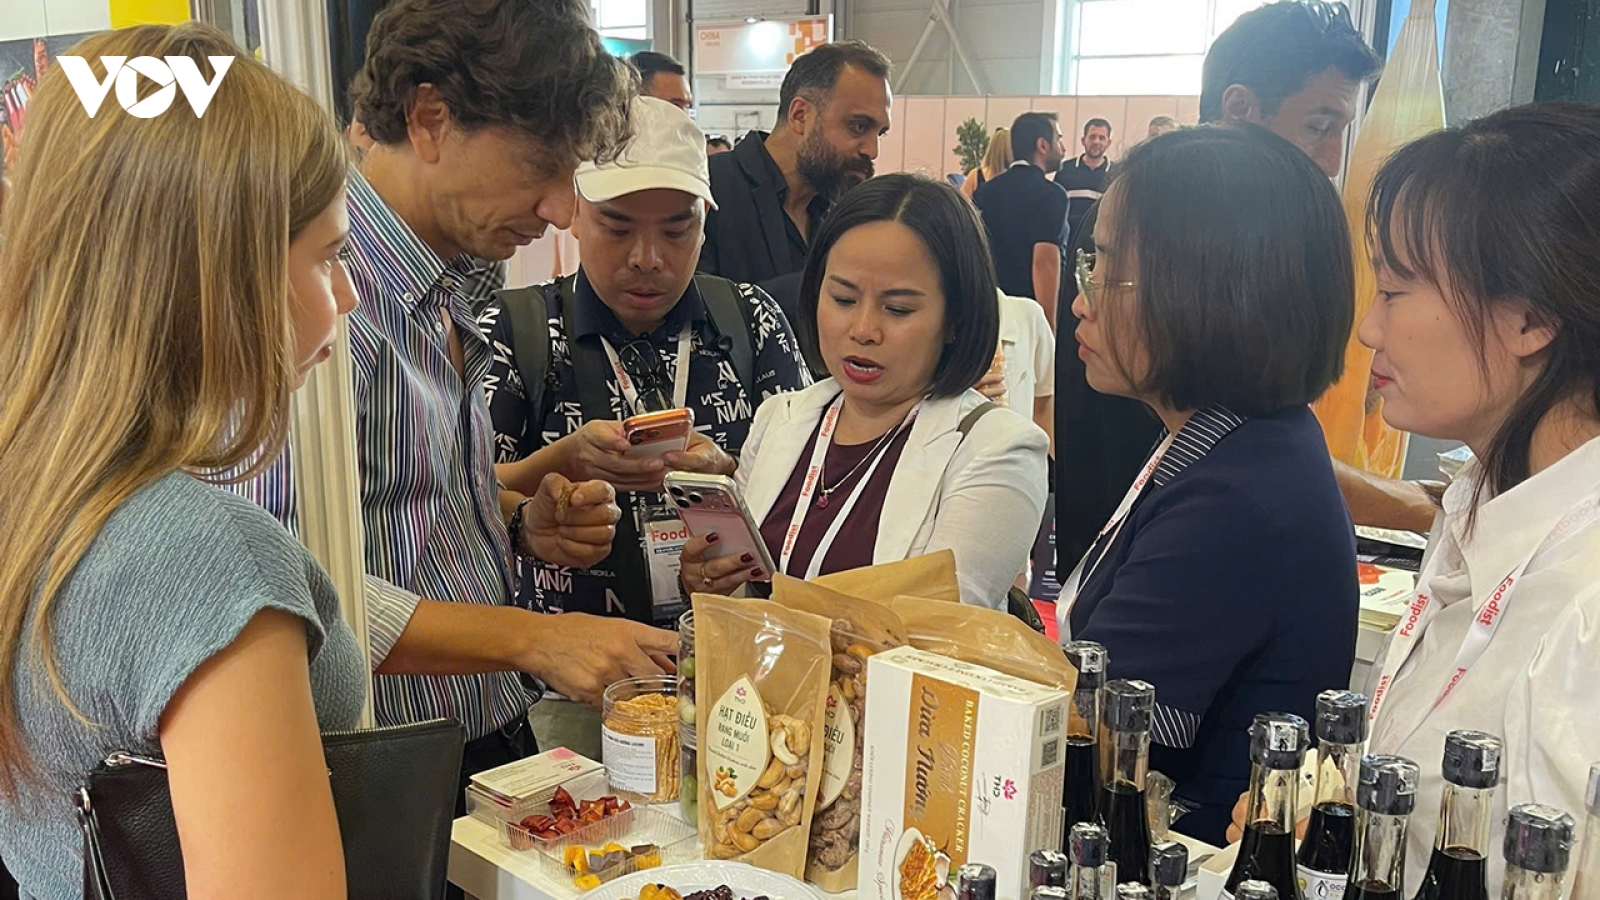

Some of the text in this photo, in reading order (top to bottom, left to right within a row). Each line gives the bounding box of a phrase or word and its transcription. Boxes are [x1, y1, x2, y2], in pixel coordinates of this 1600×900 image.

[821, 406, 838, 437] Foodist
[801, 465, 820, 497] Foodist
[651, 526, 687, 542] Food
[783, 523, 799, 556] Foodist
[1400, 594, 1429, 637] Foodist
[1476, 576, 1514, 626] Foodist
[718, 704, 758, 730] HẠT ĐIỀU
[954, 699, 975, 853] BAKED COCONUT CRACKER
